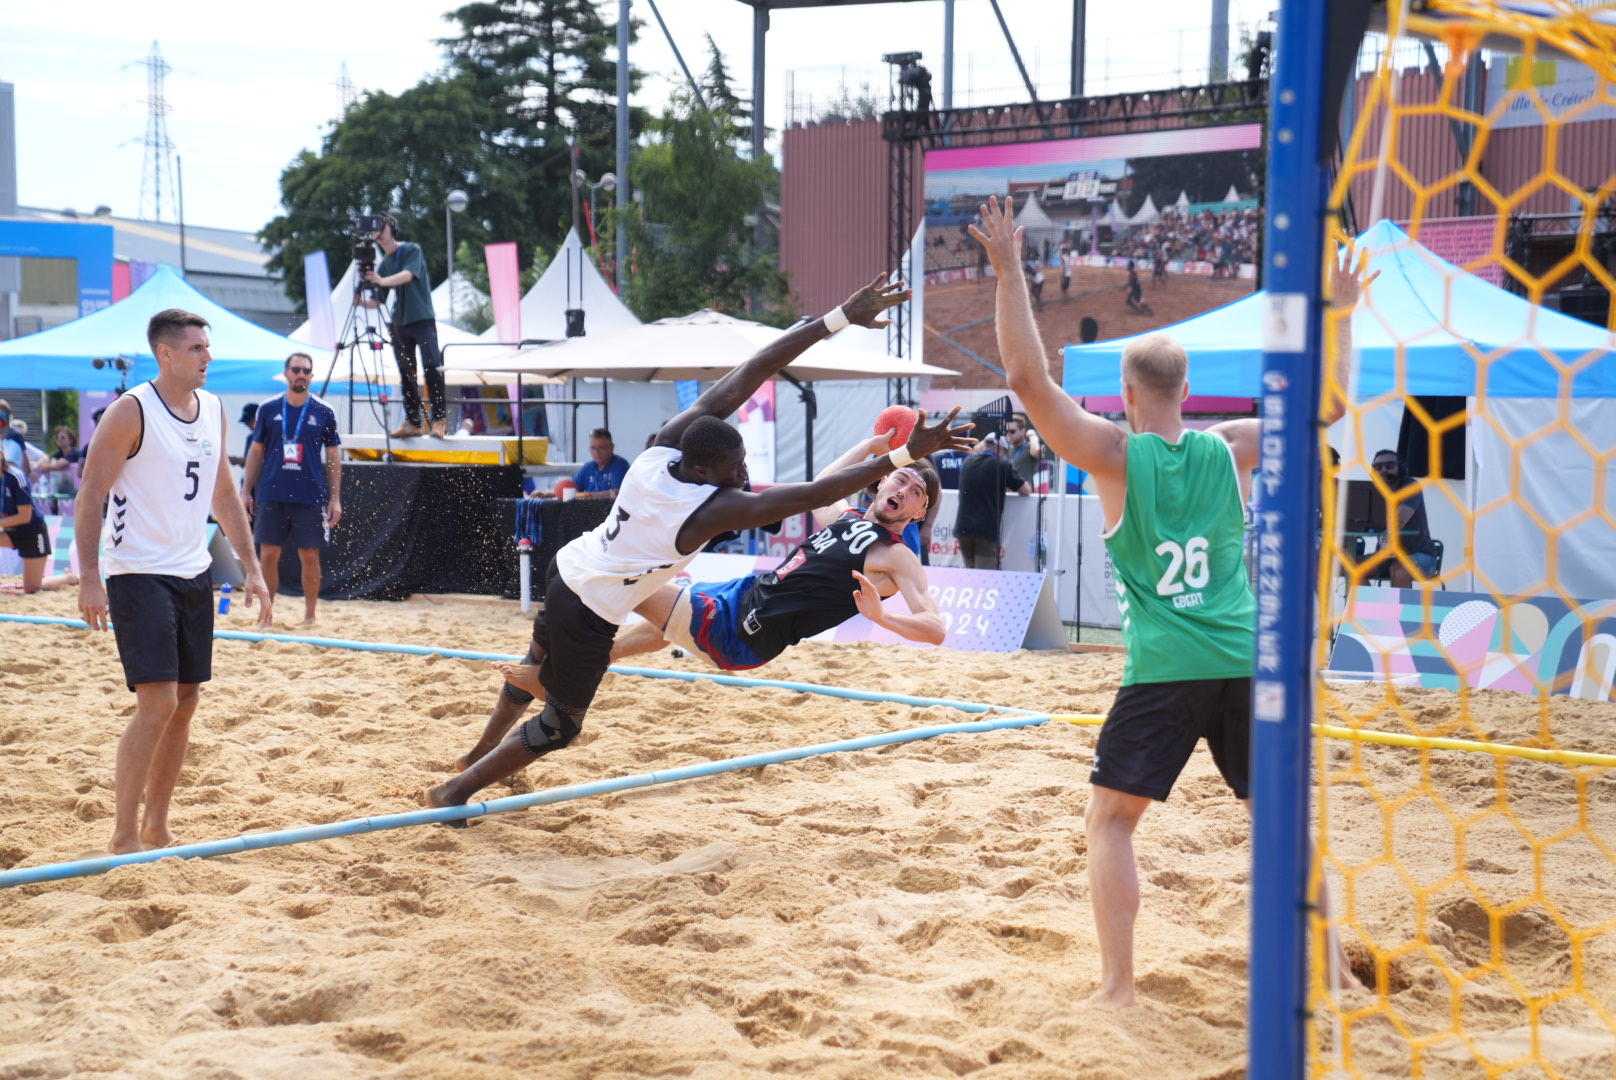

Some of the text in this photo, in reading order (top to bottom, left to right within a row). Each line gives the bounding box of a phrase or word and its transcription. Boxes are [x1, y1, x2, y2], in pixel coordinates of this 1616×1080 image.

[184, 461, 200, 501] 5
[841, 520, 879, 555] 90
[1155, 536, 1210, 596] 26
[1172, 592, 1204, 609] EBERT
